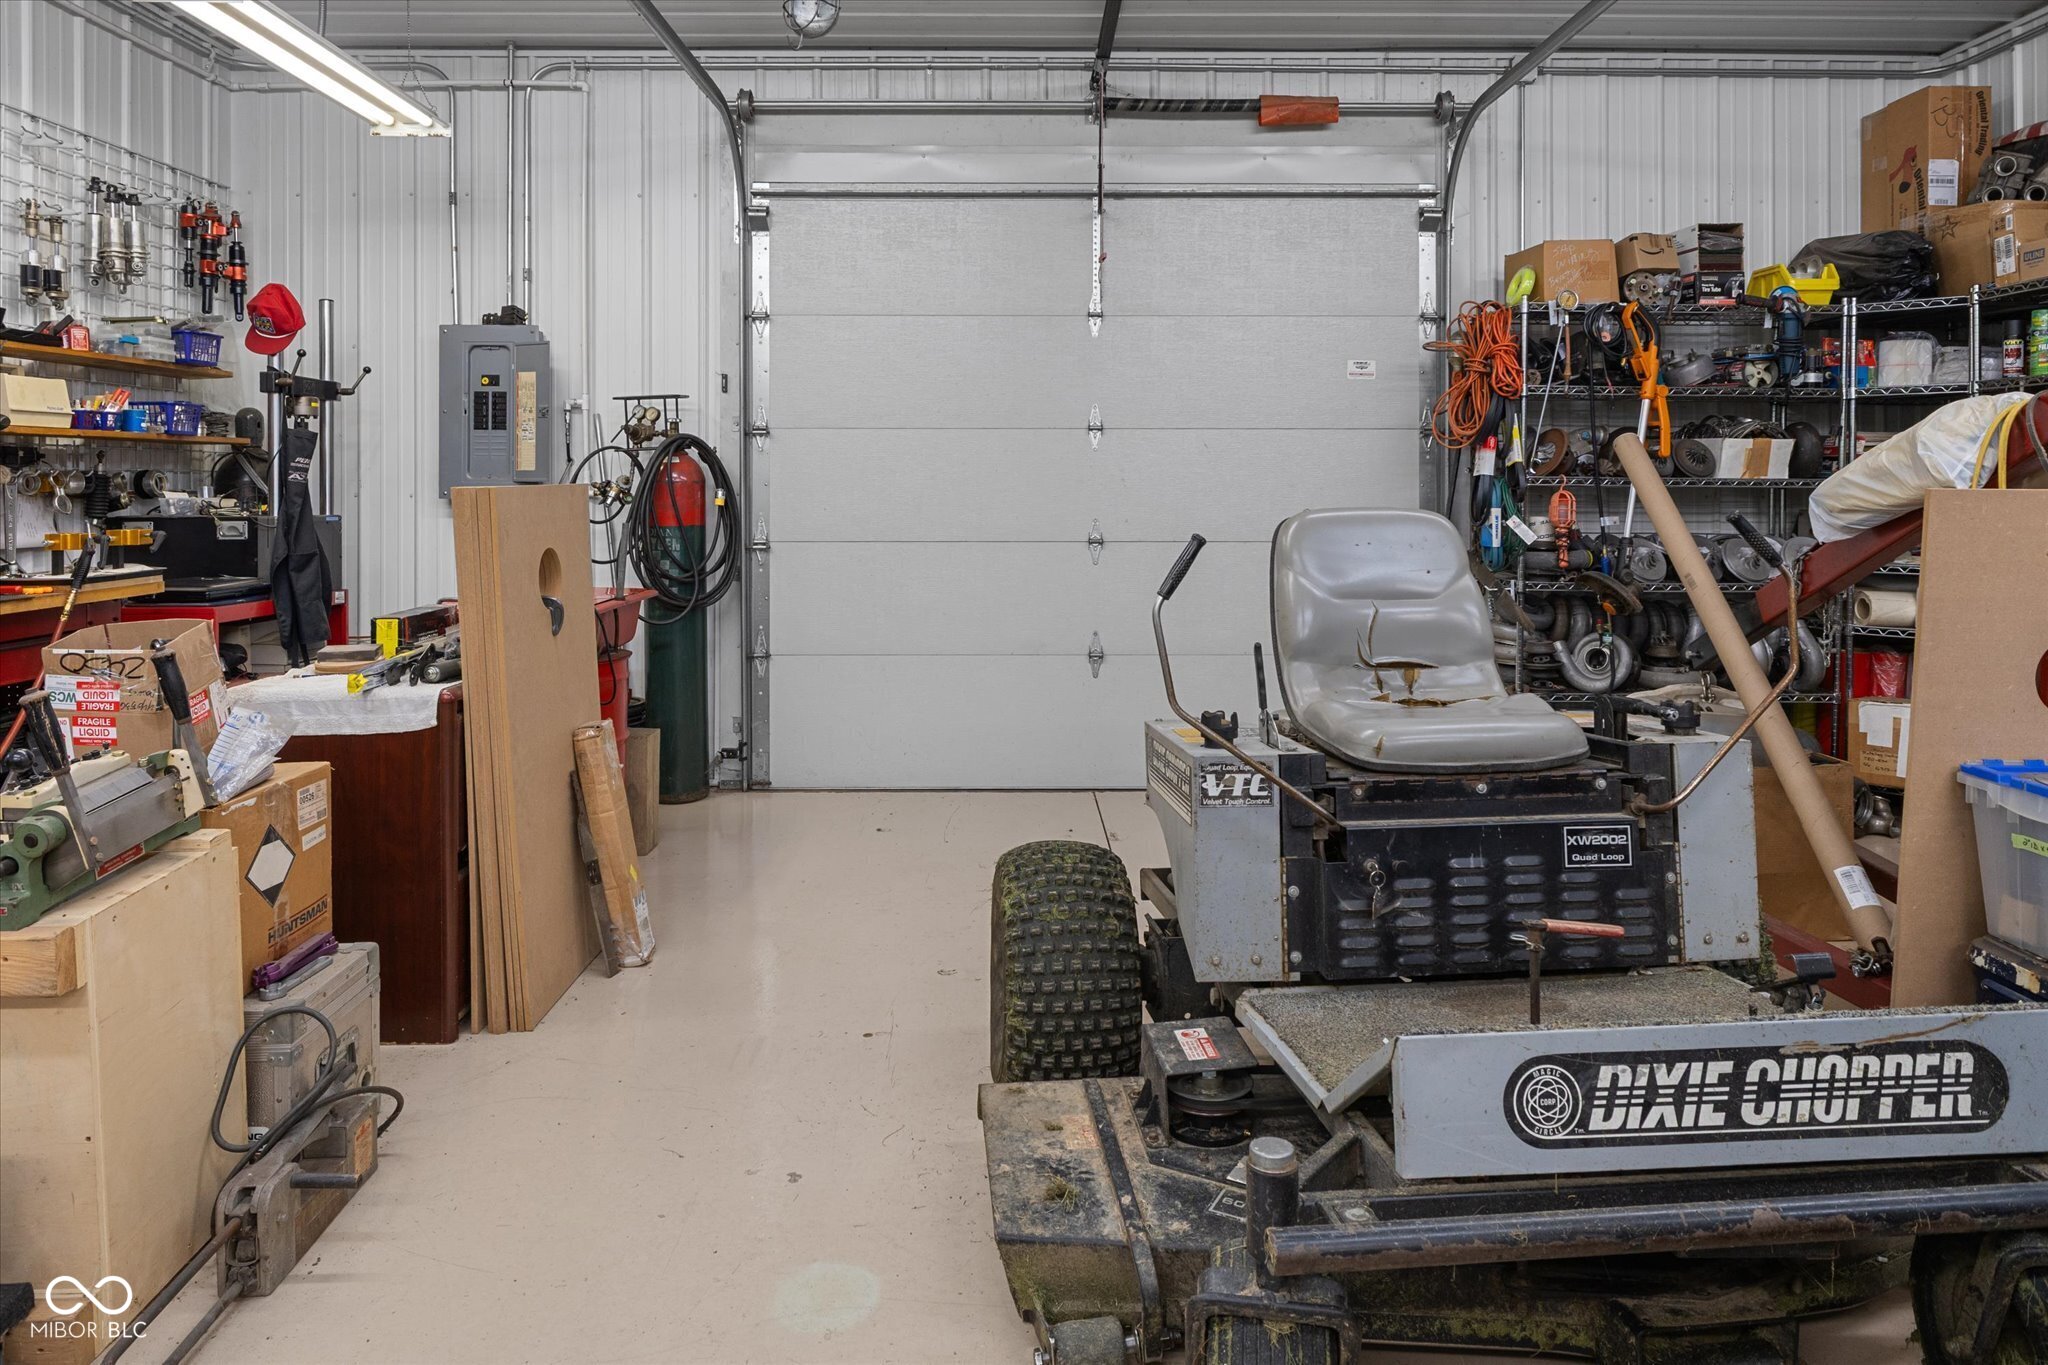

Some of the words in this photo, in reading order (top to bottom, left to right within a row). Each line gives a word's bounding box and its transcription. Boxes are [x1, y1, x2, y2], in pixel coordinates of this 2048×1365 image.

[82, 691, 114, 700] LIQUID
[81, 702, 114, 710] FRAGILE
[77, 717, 111, 726] FRAGILE
[79, 728, 110, 737] LIQUID
[1206, 774, 1268, 796] VTC
[1567, 834, 1627, 846] XW2002
[1572, 853, 1598, 861] Quad
[1601, 853, 1625, 862] Loop
[268, 898, 328, 944] HUNTSMAN
[1532, 1068, 1562, 1078] MAGIC
[1588, 1060, 1734, 1131] DIXIE
[1741, 1052, 1975, 1126] CHOPPER
[1534, 1126, 1563, 1136] CIRCLE
